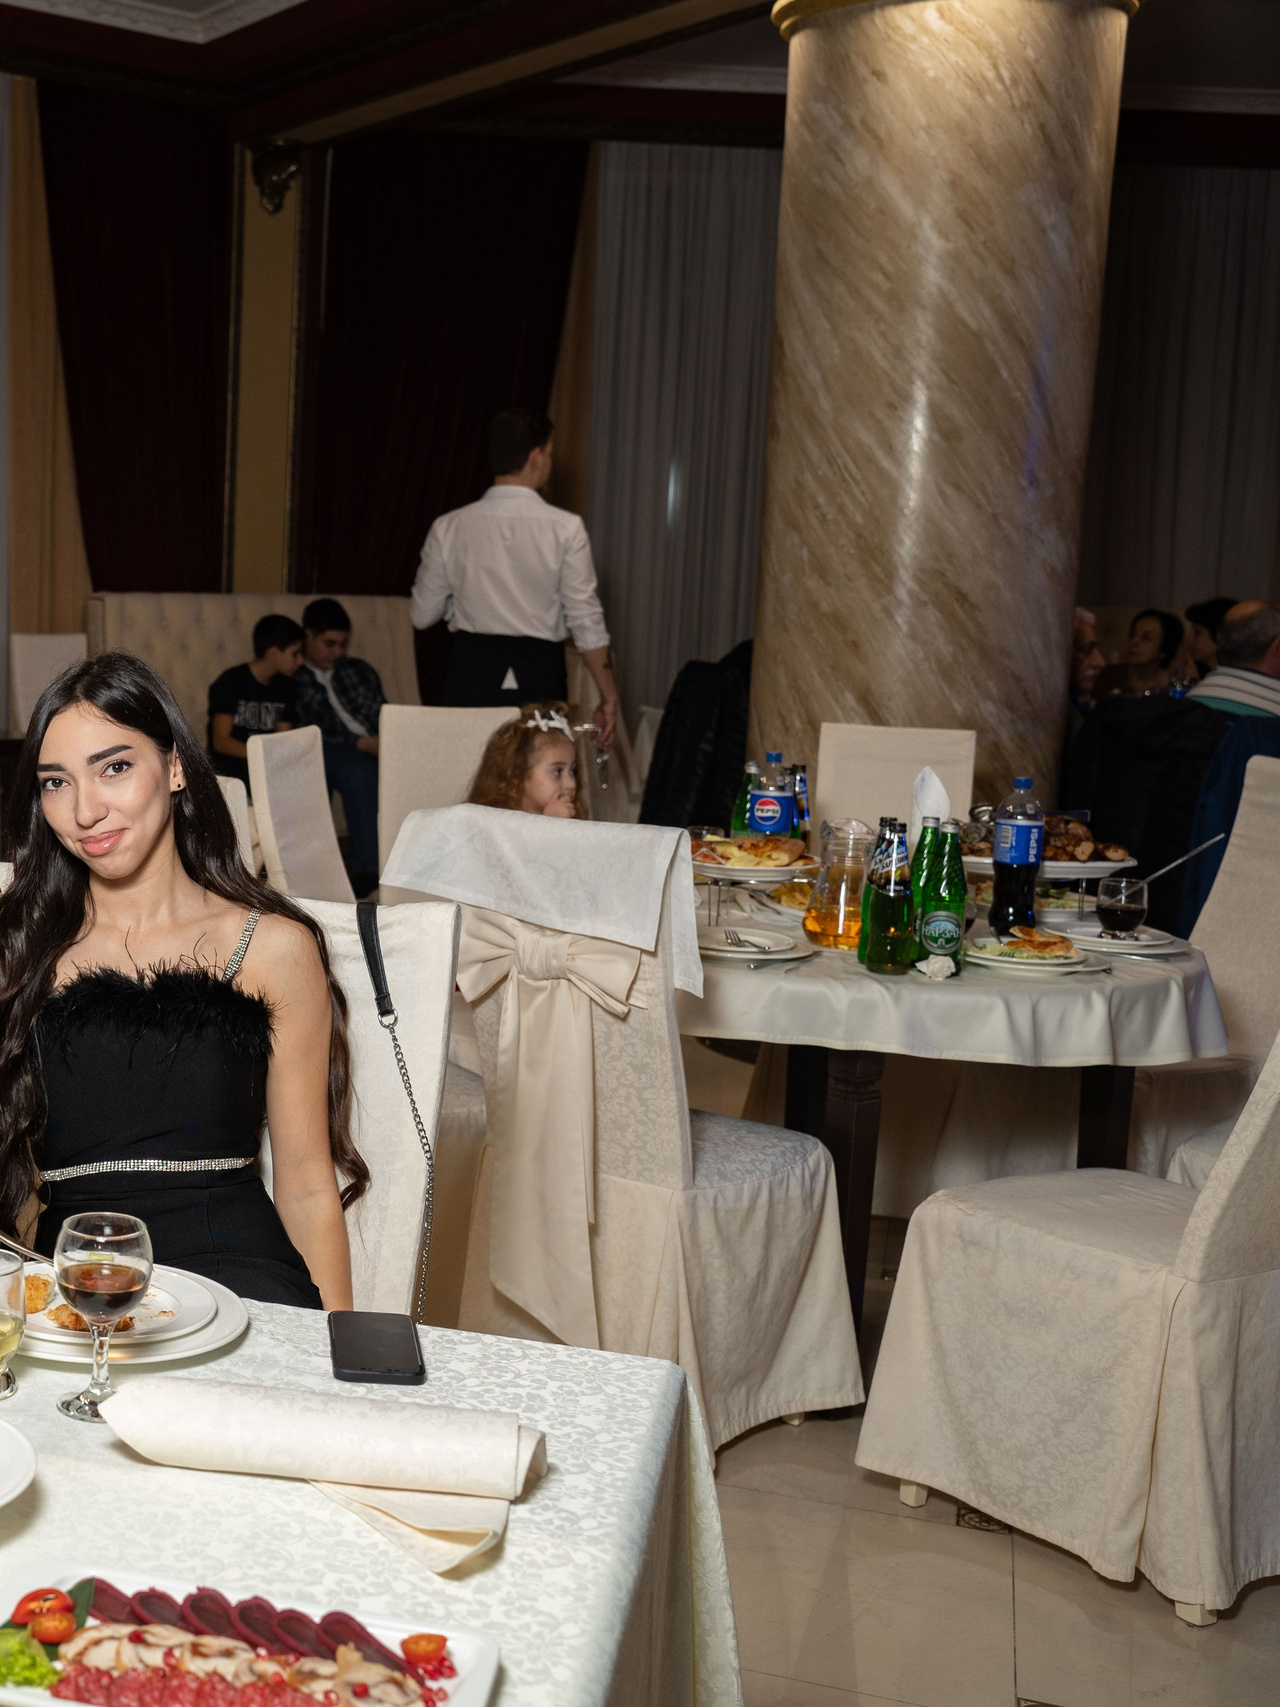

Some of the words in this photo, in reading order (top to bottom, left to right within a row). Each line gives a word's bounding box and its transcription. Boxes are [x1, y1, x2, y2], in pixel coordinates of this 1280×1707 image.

[755, 807, 779, 815] PEPSI
[1028, 828, 1039, 863] PEPSI
[922, 924, 961, 939] НАРЗАН
